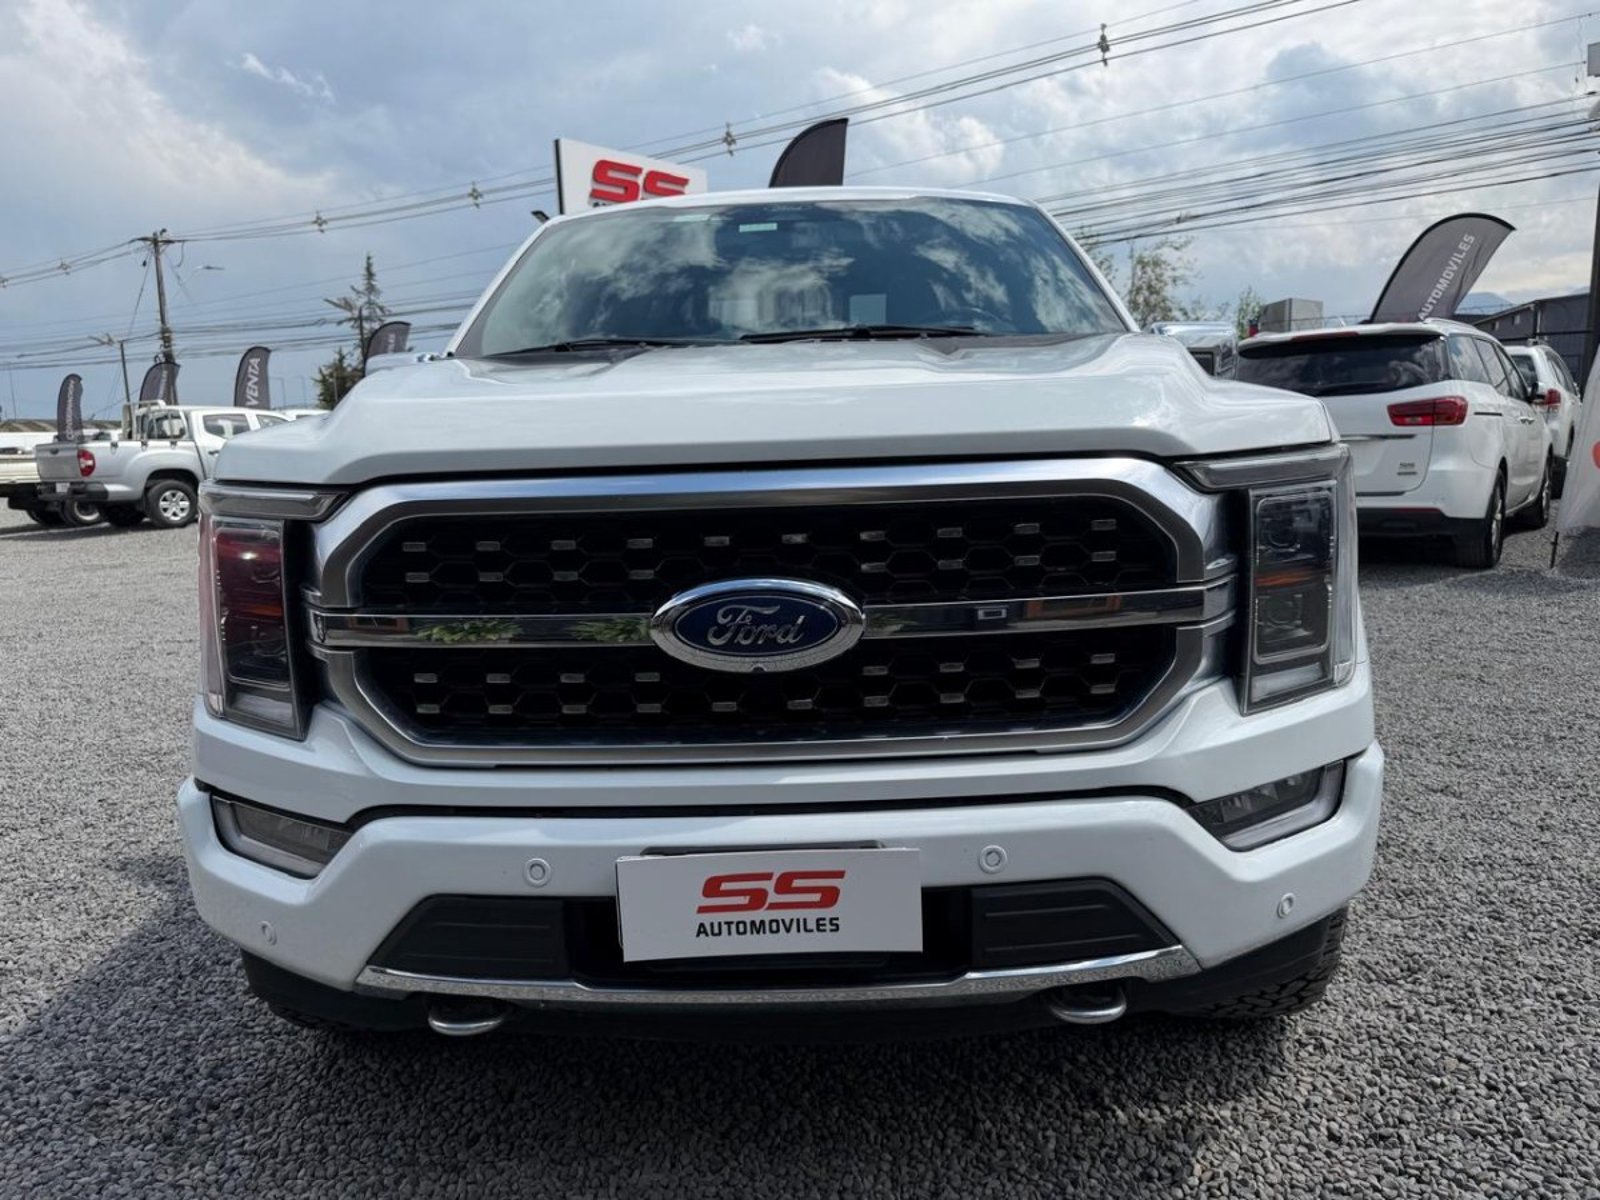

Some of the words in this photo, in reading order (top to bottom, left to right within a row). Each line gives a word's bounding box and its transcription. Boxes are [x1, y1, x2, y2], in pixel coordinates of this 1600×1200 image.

[590, 159, 690, 203] SS
[1418, 233, 1475, 320] AUTOMOVILES
[245, 357, 261, 405] VENTA
[707, 604, 805, 646] Ford
[696, 870, 846, 914] SS
[696, 917, 840, 938] AUTOMOVILES
